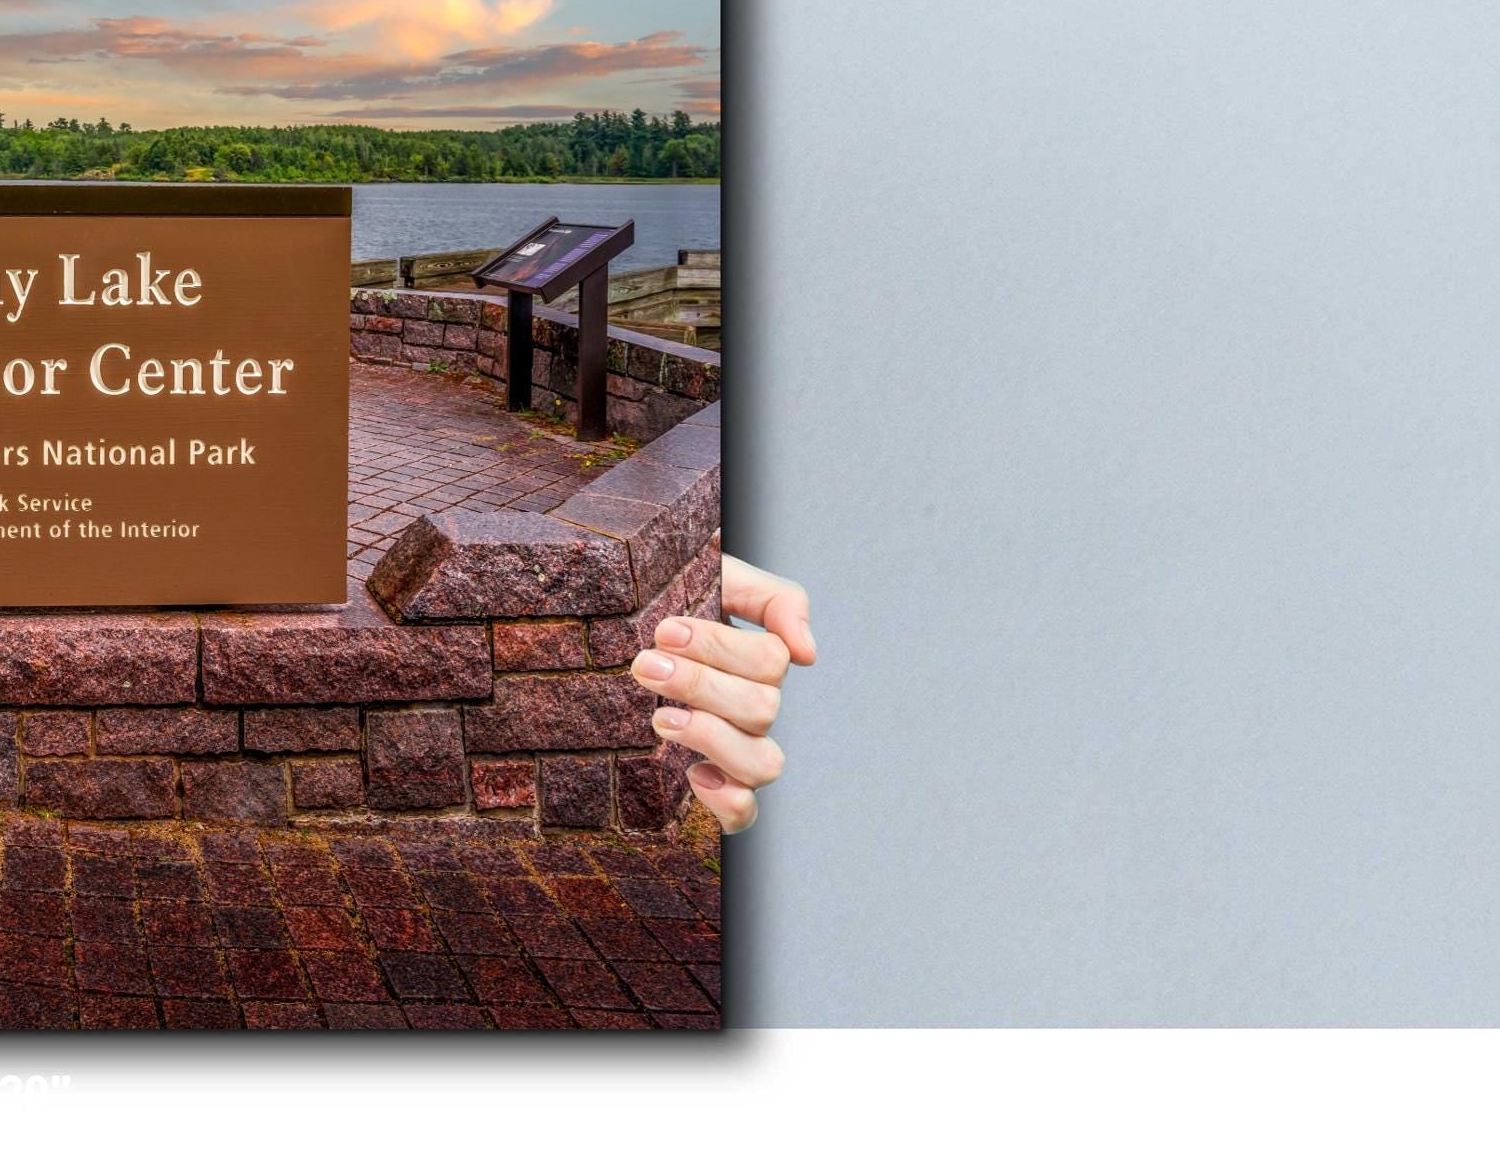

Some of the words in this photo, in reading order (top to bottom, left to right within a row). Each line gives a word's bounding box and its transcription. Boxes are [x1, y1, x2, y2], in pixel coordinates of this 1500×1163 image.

[58, 250, 203, 307] Lake
[88, 342, 295, 396] Center
[43, 438, 175, 466] National
[189, 437, 257, 465] Park
[17, 494, 93, 512] Service
[49, 520, 72, 538] of
[78, 521, 113, 538] the
[121, 520, 200, 538] Interior
